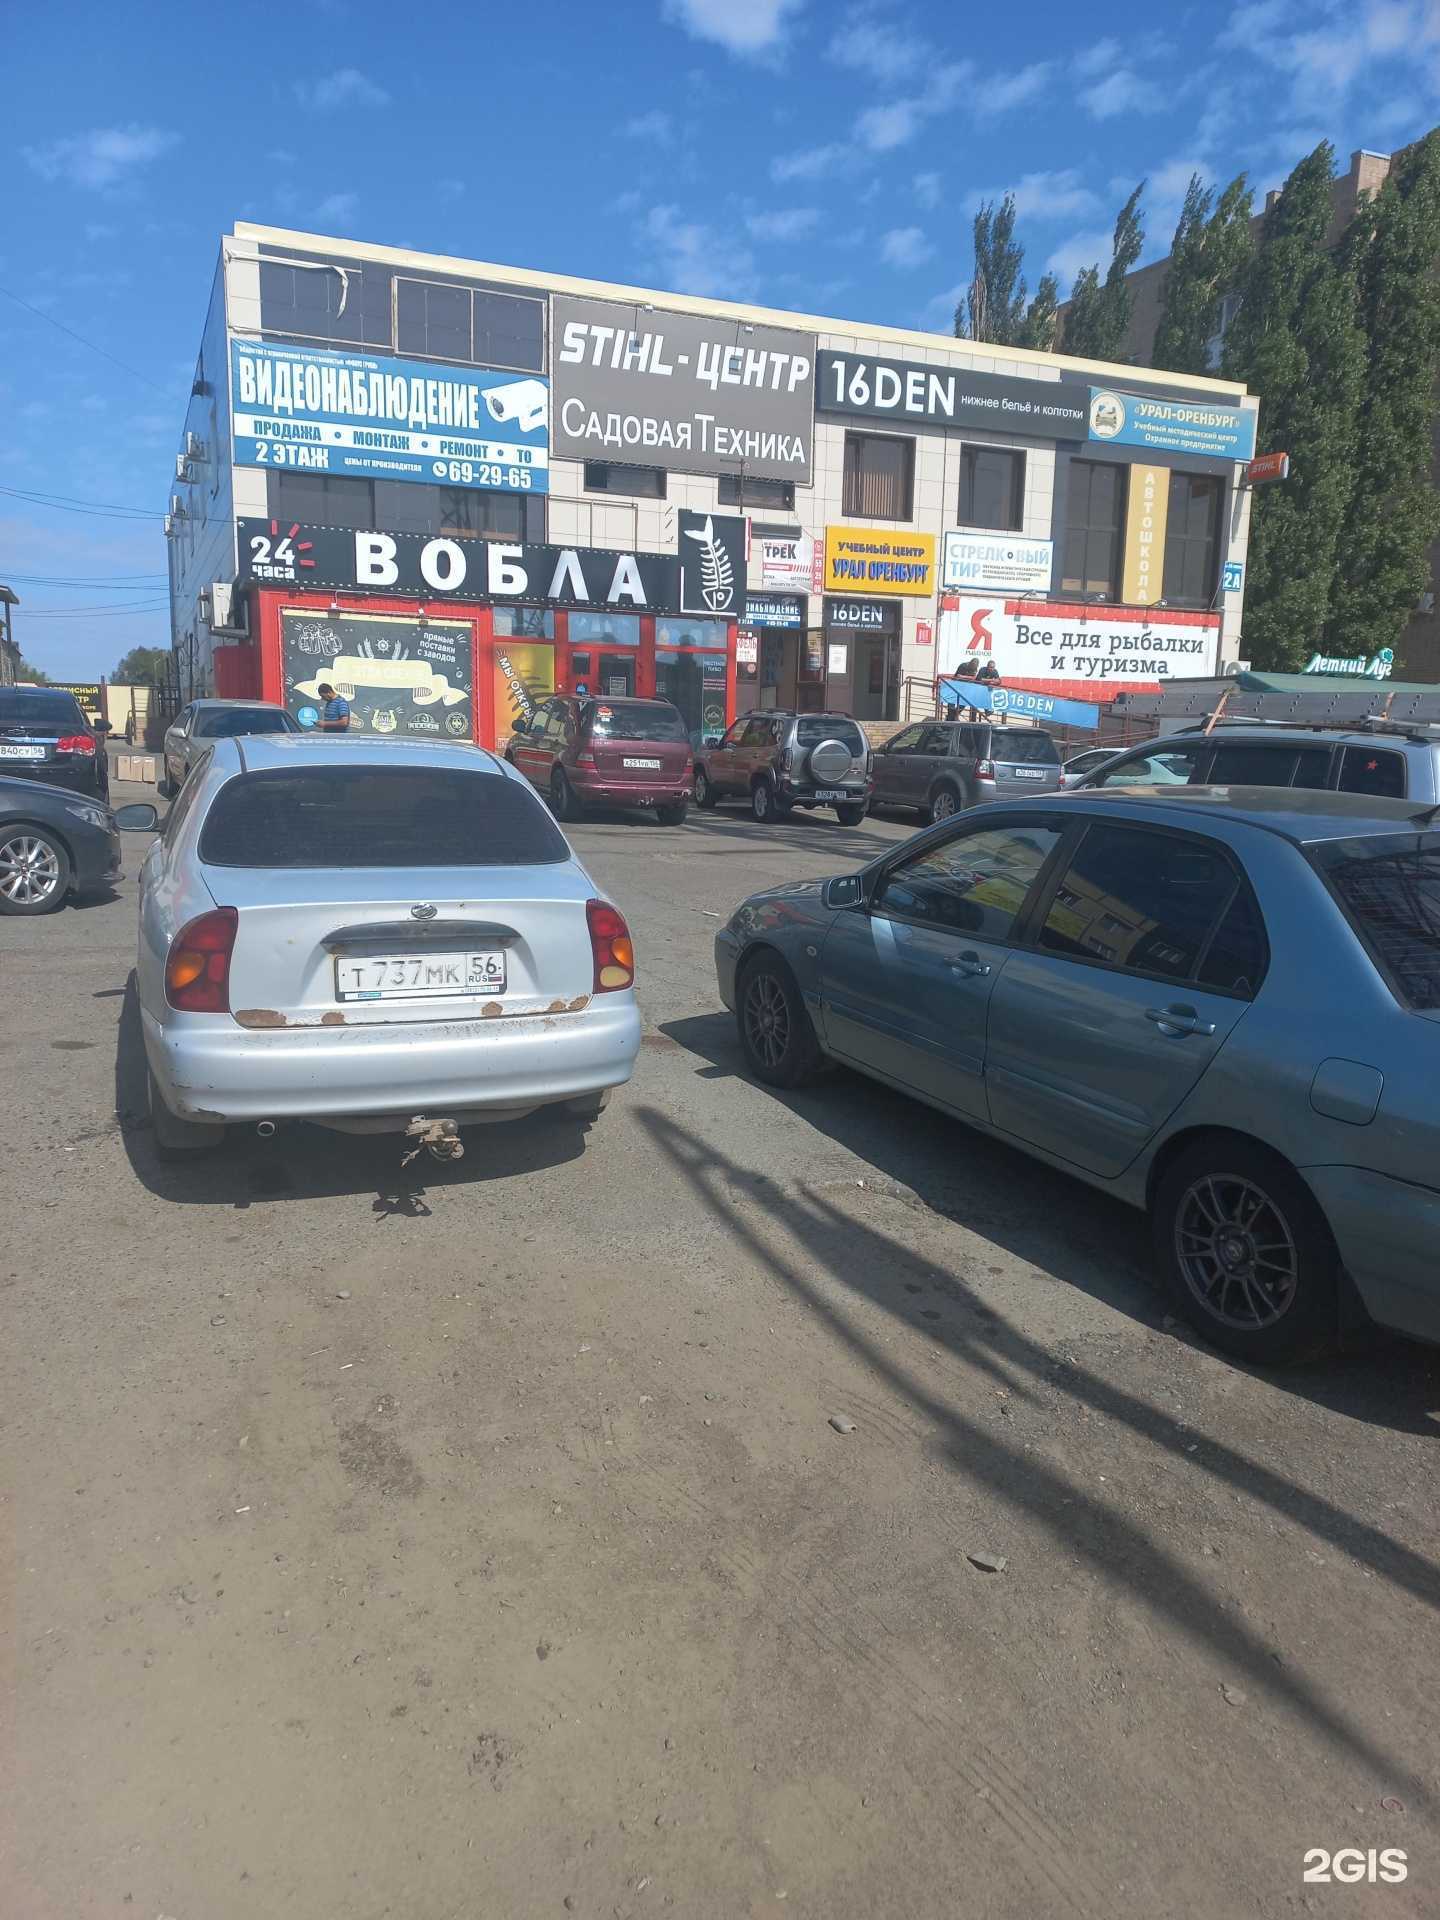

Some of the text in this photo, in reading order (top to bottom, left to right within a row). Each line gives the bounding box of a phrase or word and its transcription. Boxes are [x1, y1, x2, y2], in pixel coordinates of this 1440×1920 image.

[239, 355, 480, 430] ВИДЕОНАБЛЮДЕНИЕ
[832, 360, 955, 416] 16DEN
[961, 395, 1083, 419] нижнее бельё и колготки
[254, 420, 532, 463] ПРОДАЖА МОНТАЖ РЕМОНТ ТО
[256, 442, 329, 468] 2 ЭТАЖ
[449, 461, 532, 488] 69-29-65
[1137, 472, 1155, 601] АВТОШКОЛА
[250, 536, 295, 565] 24
[838, 541, 925, 557] УЧЕБНЫЙ ЦЕНТР
[252, 565, 295, 579] часа
[355, 532, 648, 605] ВОБЛА
[833, 559, 929, 584] УРАЛ ОРЕНБУРГ
[951, 563, 981, 578] ТИР
[832, 603, 883, 622] 16DEN
[419, 640, 456, 654] поставки
[423, 631, 454, 645] прямые
[1015, 624, 1204, 655] Все для рыбалки
[423, 651, 456, 663] заводов
[499, 657, 514, 678] МЫ
[1050, 655, 1169, 677] и туризма
[1306, 653, 1392, 680] Летний Луг
[1010, 693, 1024, 706] 16
[1027, 695, 1054, 712] DEN
[472, 956, 497, 974] 56
